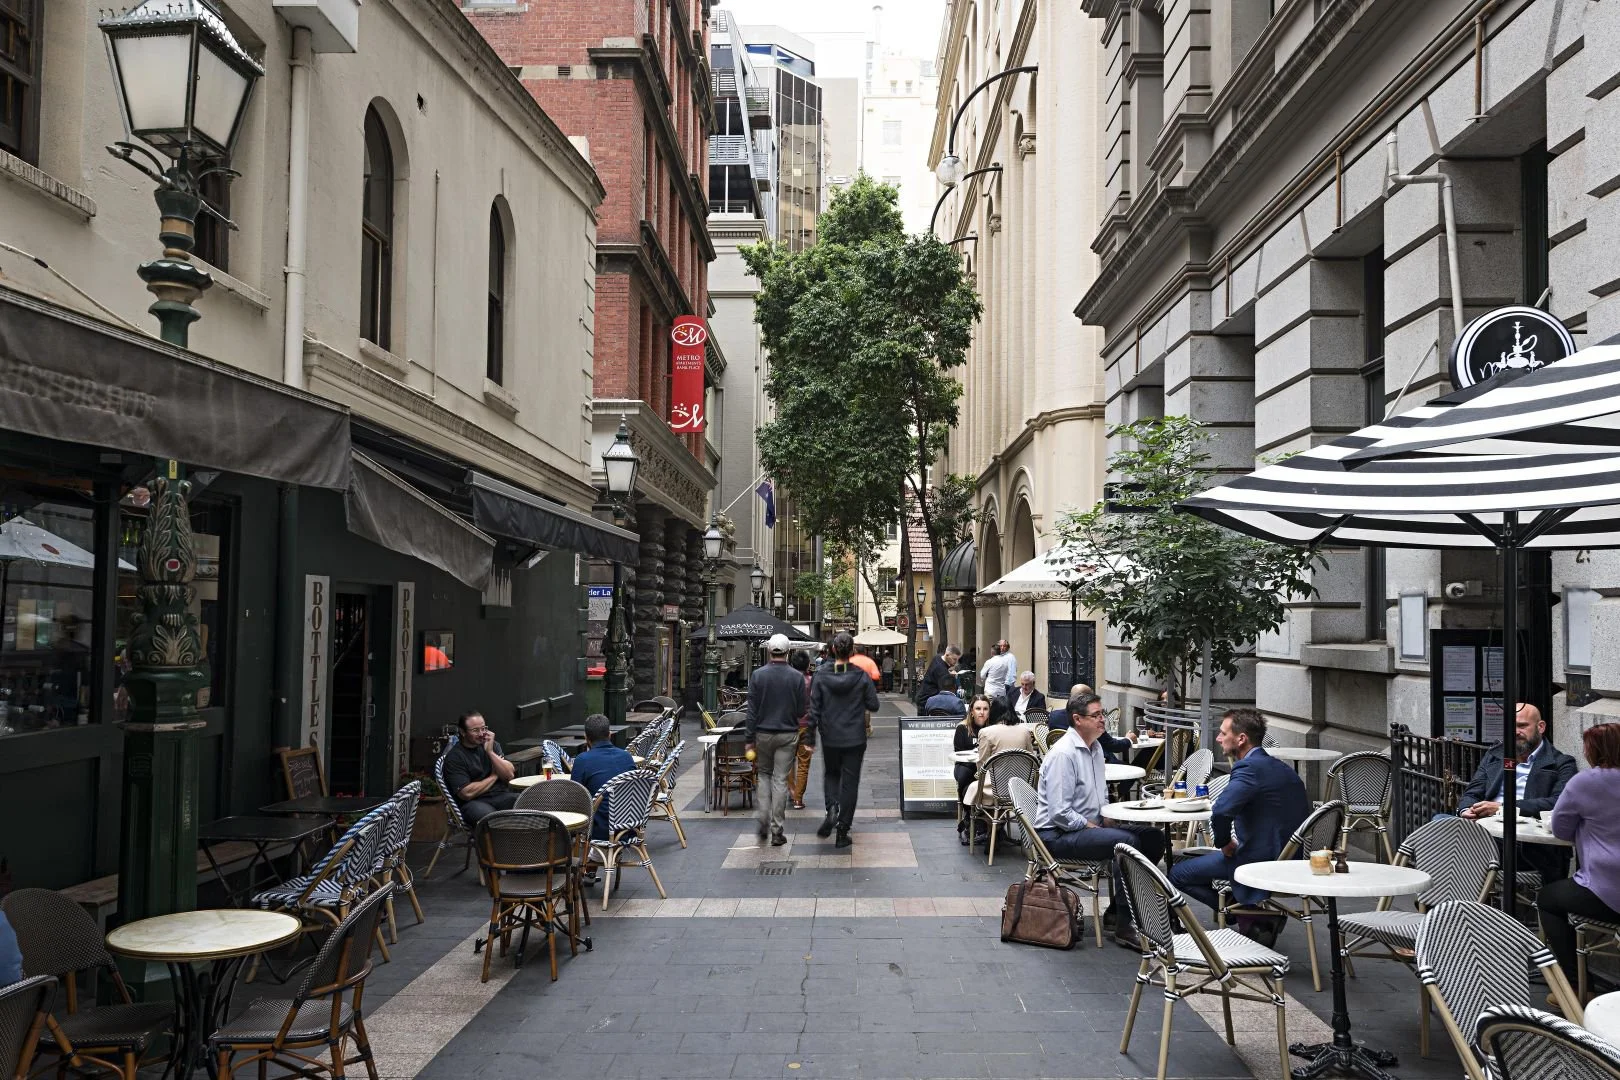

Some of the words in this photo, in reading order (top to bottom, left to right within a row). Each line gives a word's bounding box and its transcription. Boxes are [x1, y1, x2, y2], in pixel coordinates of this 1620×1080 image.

[309, 582, 323, 747] BOTTLES
[602, 588, 611, 596] La
[399, 588, 410, 771] PROVIDORE
